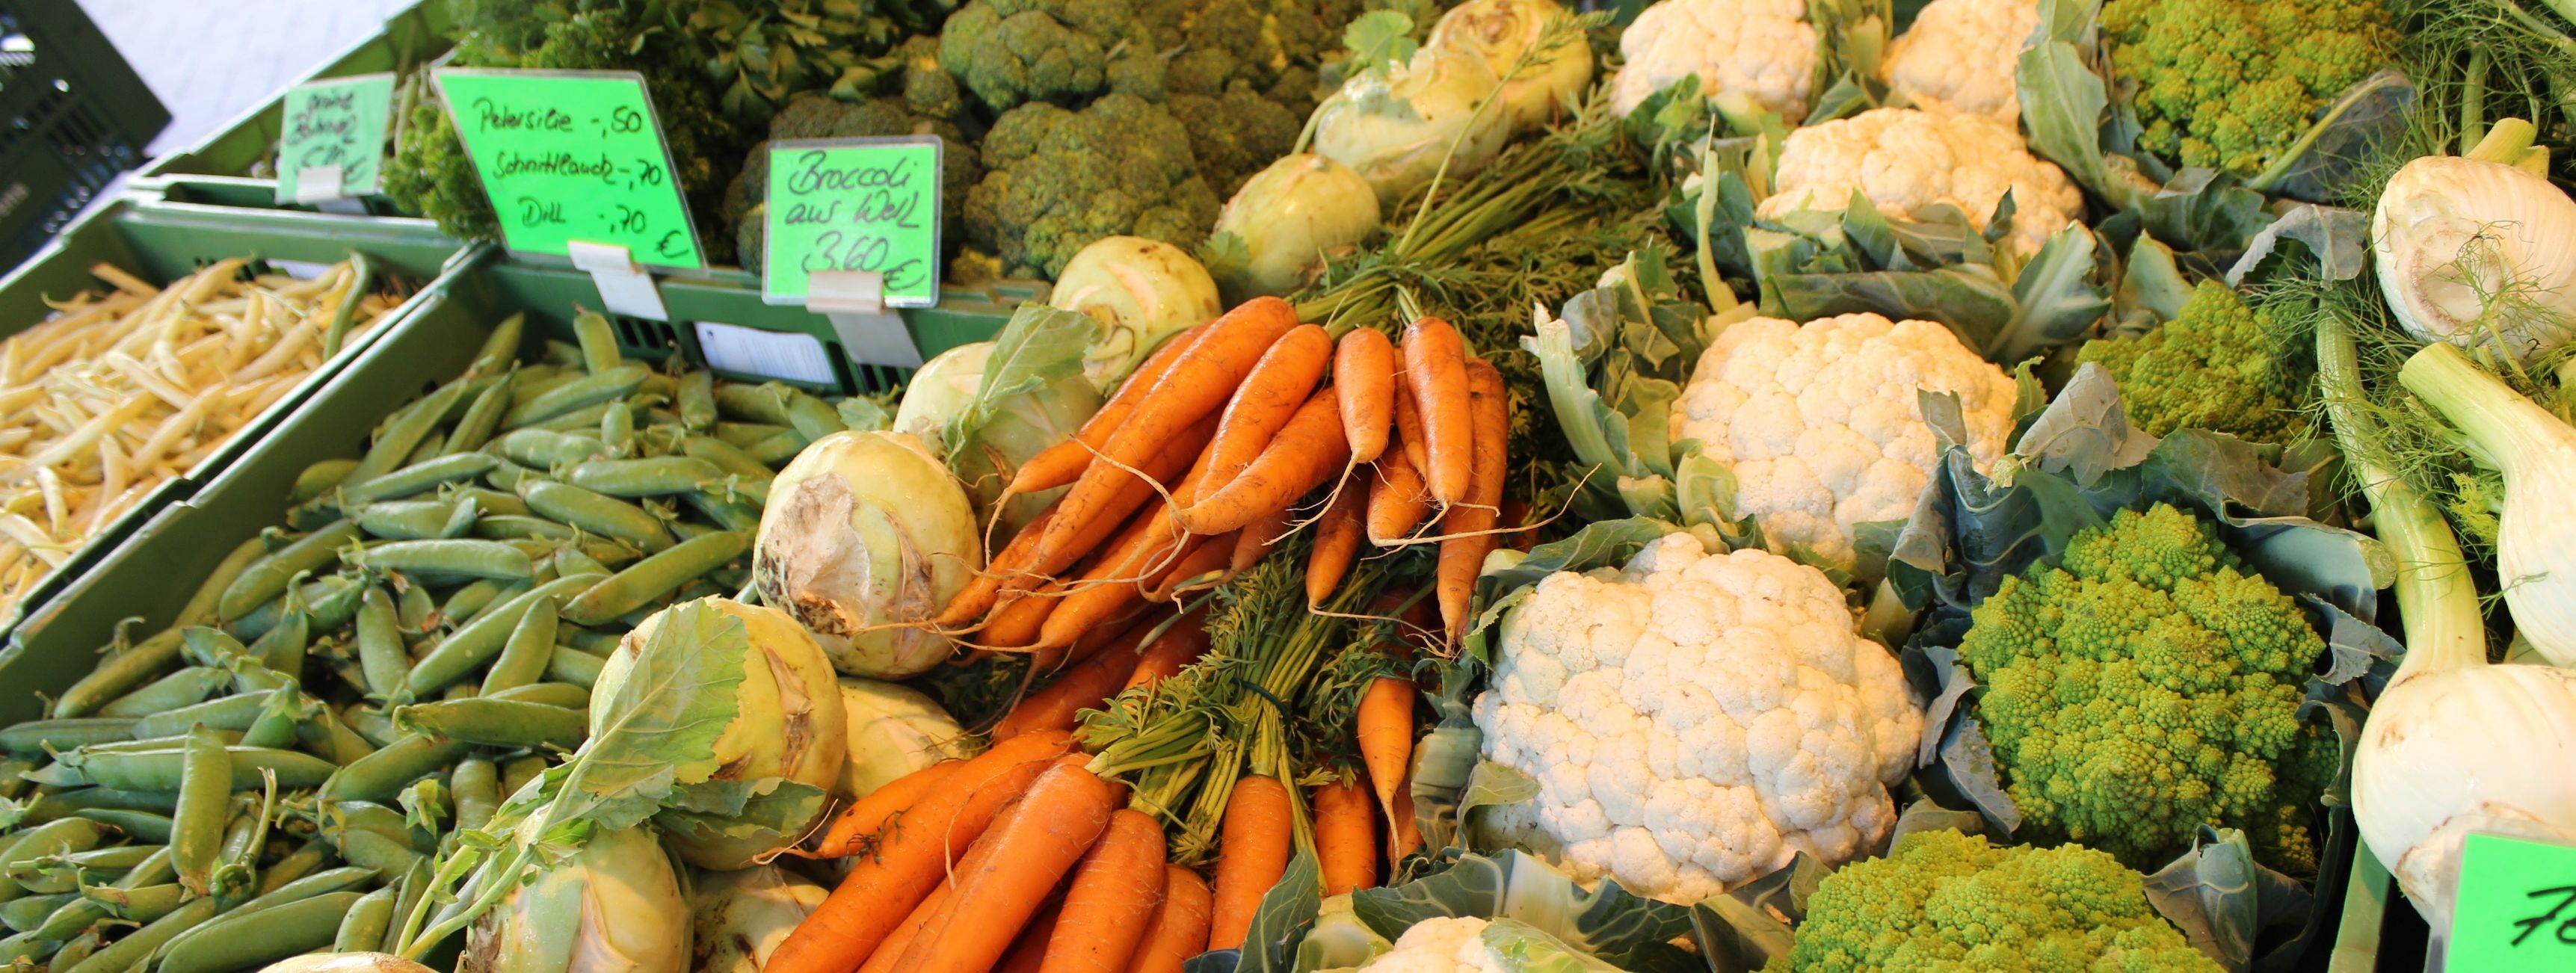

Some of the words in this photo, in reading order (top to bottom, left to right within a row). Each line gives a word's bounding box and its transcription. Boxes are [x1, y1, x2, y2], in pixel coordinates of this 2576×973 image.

[472, 97, 573, 133] Petersilie
[493, 151, 616, 185] Schnittlauch
[789, 150, 919, 195] Broccoli
[517, 196, 567, 227] Dill
[785, 200, 842, 224] aus
[656, 229, 689, 259] €
[884, 259, 925, 291] €
